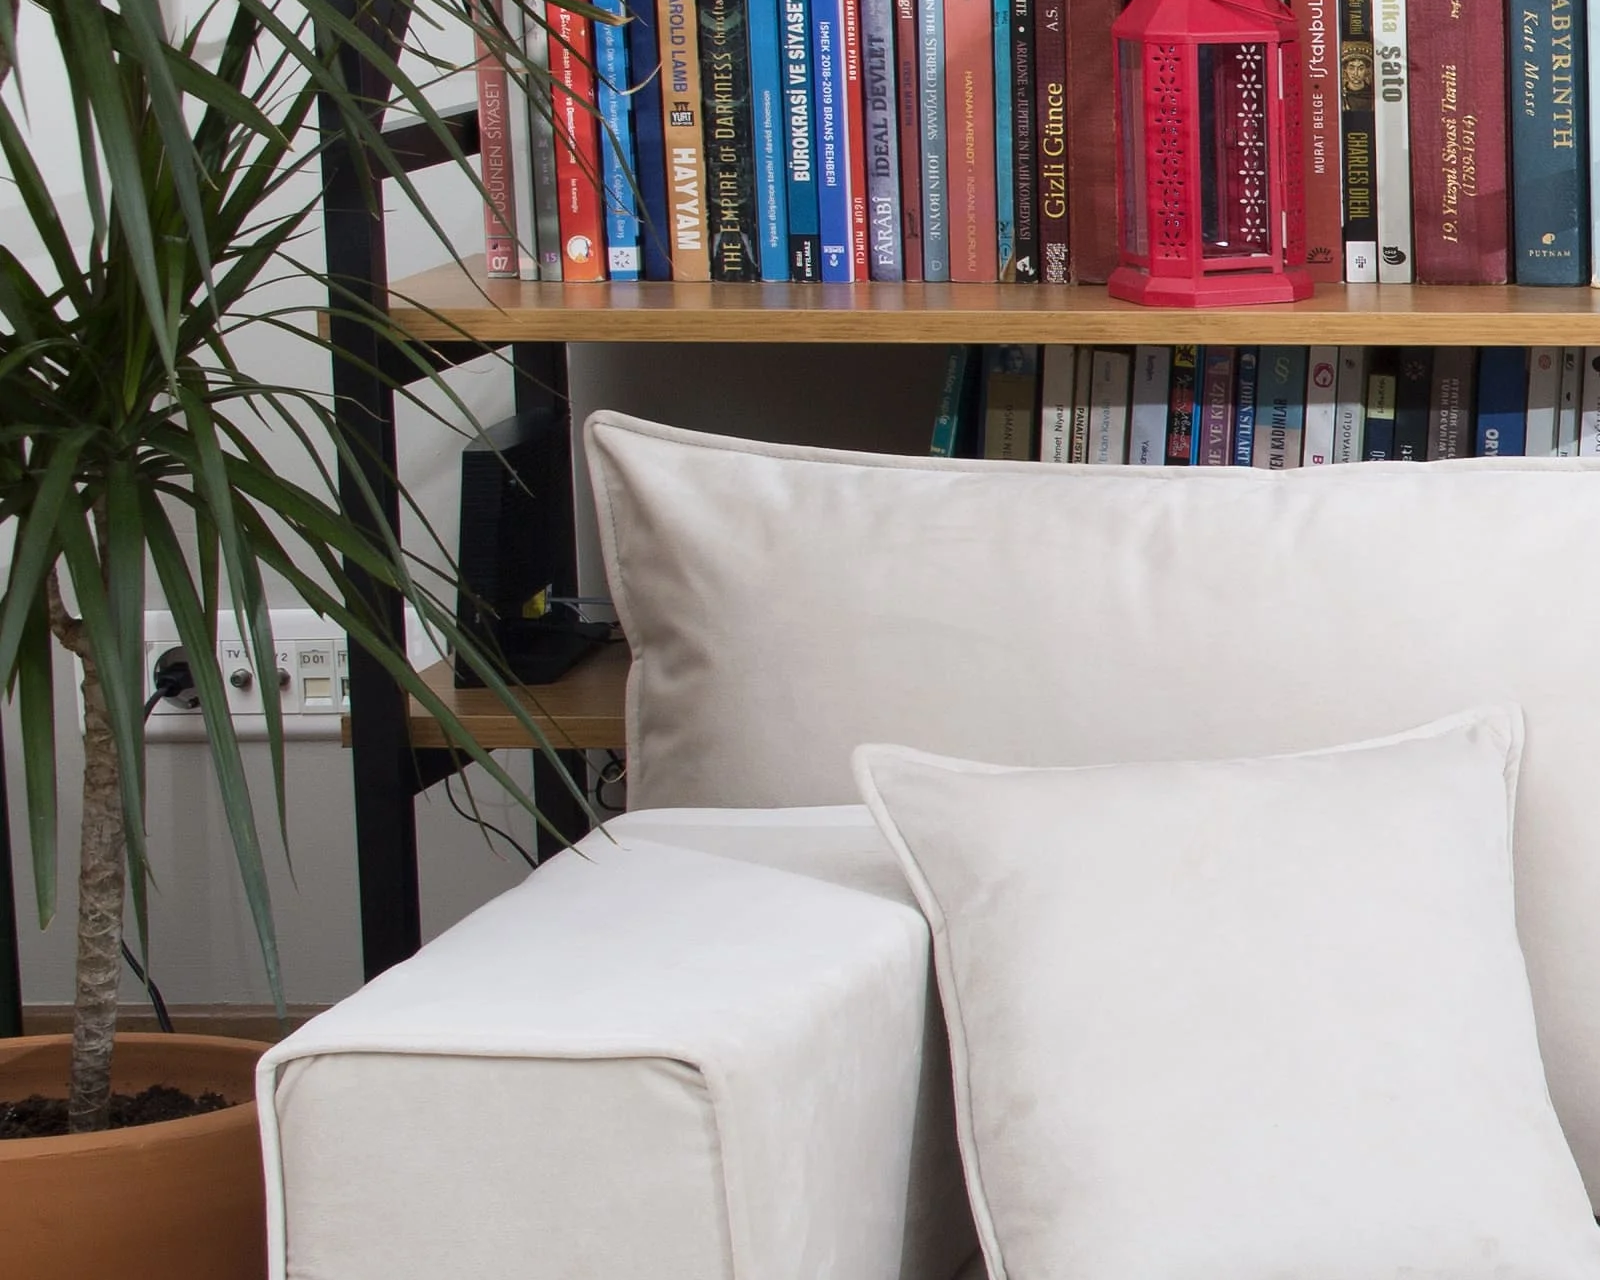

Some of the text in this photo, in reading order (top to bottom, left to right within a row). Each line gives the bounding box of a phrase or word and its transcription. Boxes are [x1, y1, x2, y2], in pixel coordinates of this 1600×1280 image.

[670, 50, 686, 92] LAMB
[788, 64, 807, 88] VE
[820, 21, 837, 186] İSMEK 2018-2019 BRANŞ REHBERİ
[1376, 46, 1405, 102] şato
[1523, 10, 1539, 117] Kate Mosse
[788, 91, 812, 181] BÜROKRASİ
[1041, 84, 1067, 218] Gizli Günce
[1348, 132, 1370, 221] CHARLES DIEHL
[672, 147, 701, 249] HAYYAM
[928, 153, 942, 240] JOHN BOYNE
[1239, 380, 1253, 413] JOHN
